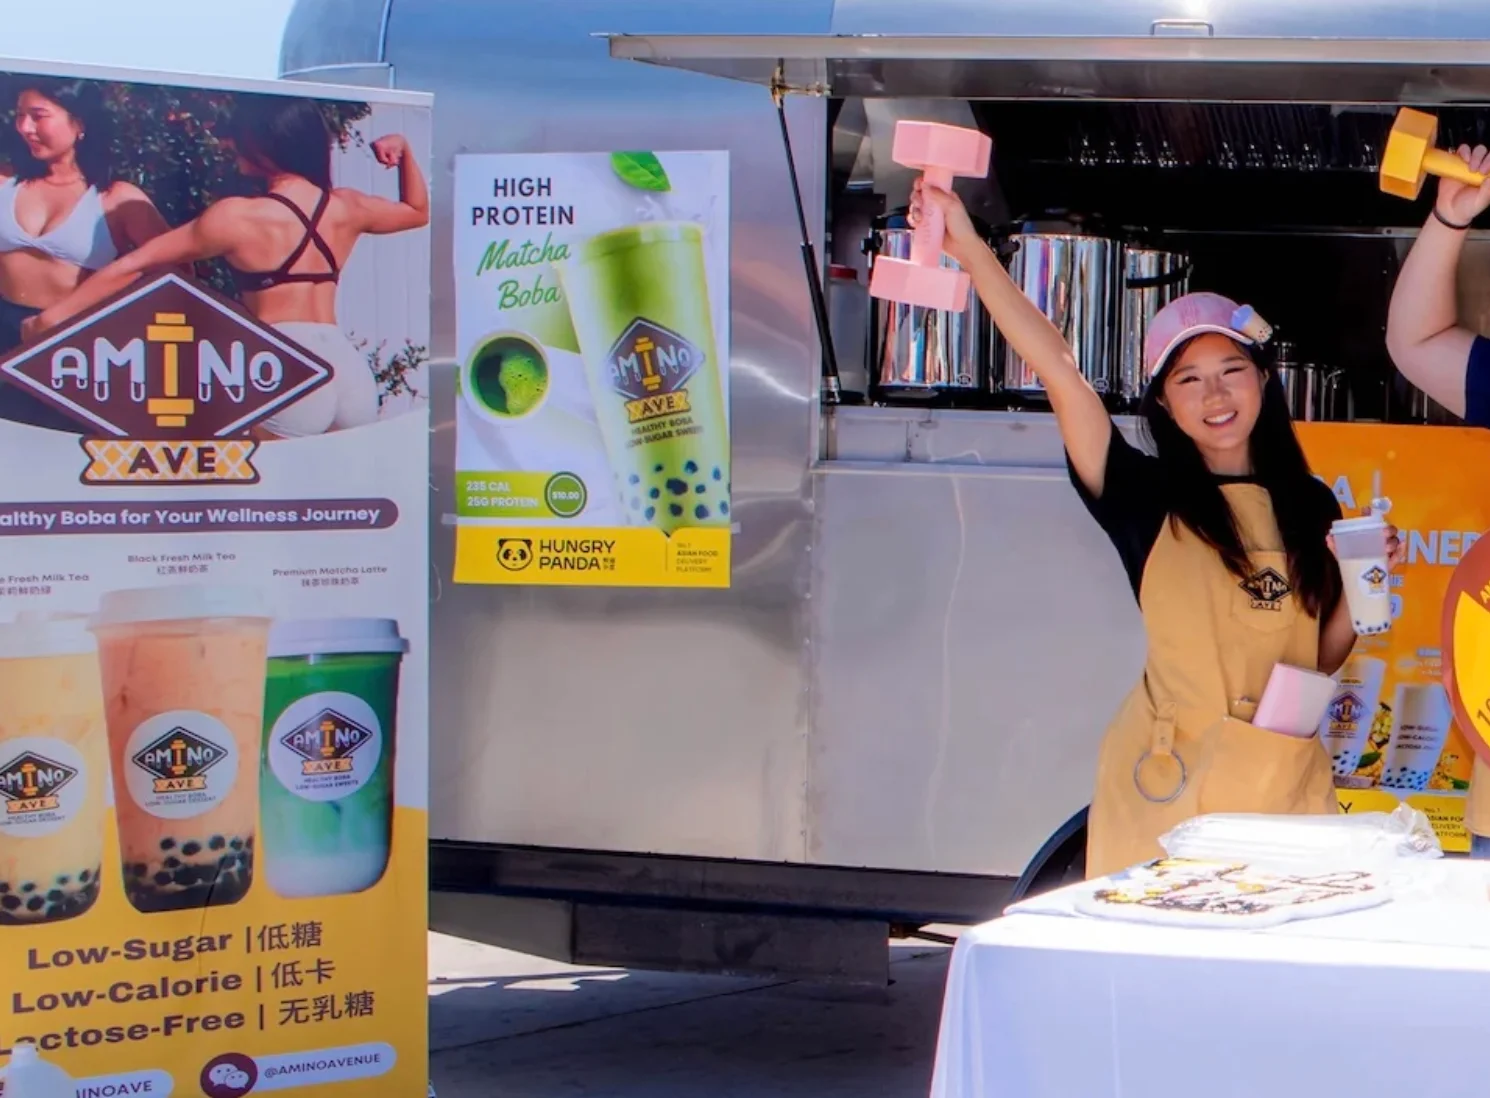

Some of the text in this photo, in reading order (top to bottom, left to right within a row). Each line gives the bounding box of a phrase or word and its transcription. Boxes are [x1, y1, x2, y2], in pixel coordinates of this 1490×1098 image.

[493, 177, 551, 197] HIGH
[471, 205, 574, 226] PROTEIN
[476, 231, 572, 277] Matcha
[497, 273, 562, 311] Boba
[51, 312, 284, 427] AMINO
[642, 396, 675, 415] AVE
[128, 446, 217, 474] AVE
[488, 481, 511, 493] CAL
[490, 496, 539, 508] PROTEIN
[60, 509, 116, 526] Boba
[120, 509, 151, 525] for
[155, 509, 203, 524] Your
[206, 507, 298, 523] Wellness
[301, 507, 381, 525] Journey
[539, 539, 616, 553] HUNGRY
[127, 552, 236, 563] Black Fresh Milk Tea
[538, 556, 601, 570] PANDA
[8, 574, 39, 583] Fresh
[42, 573, 65, 582] Milk
[68, 573, 90, 581] Tea
[272, 565, 388, 577] Premium Matcha Latte
[292, 720, 361, 757] AMINO
[144, 738, 214, 775] AMINO
[315, 761, 342, 771] AVE
[166, 779, 194, 790] AVE
[19, 800, 48, 810] AVE
[28, 934, 233, 970] Low-Sugar
[257, 920, 323, 952] 低糖
[12, 971, 243, 1014] Low-Calorie
[270, 958, 336, 989] 低卡
[0, 1011, 245, 1056] ctose-Free
[279, 990, 375, 1026] 无乳糖
[263, 1052, 382, 1079] @AMINOAVENUE
